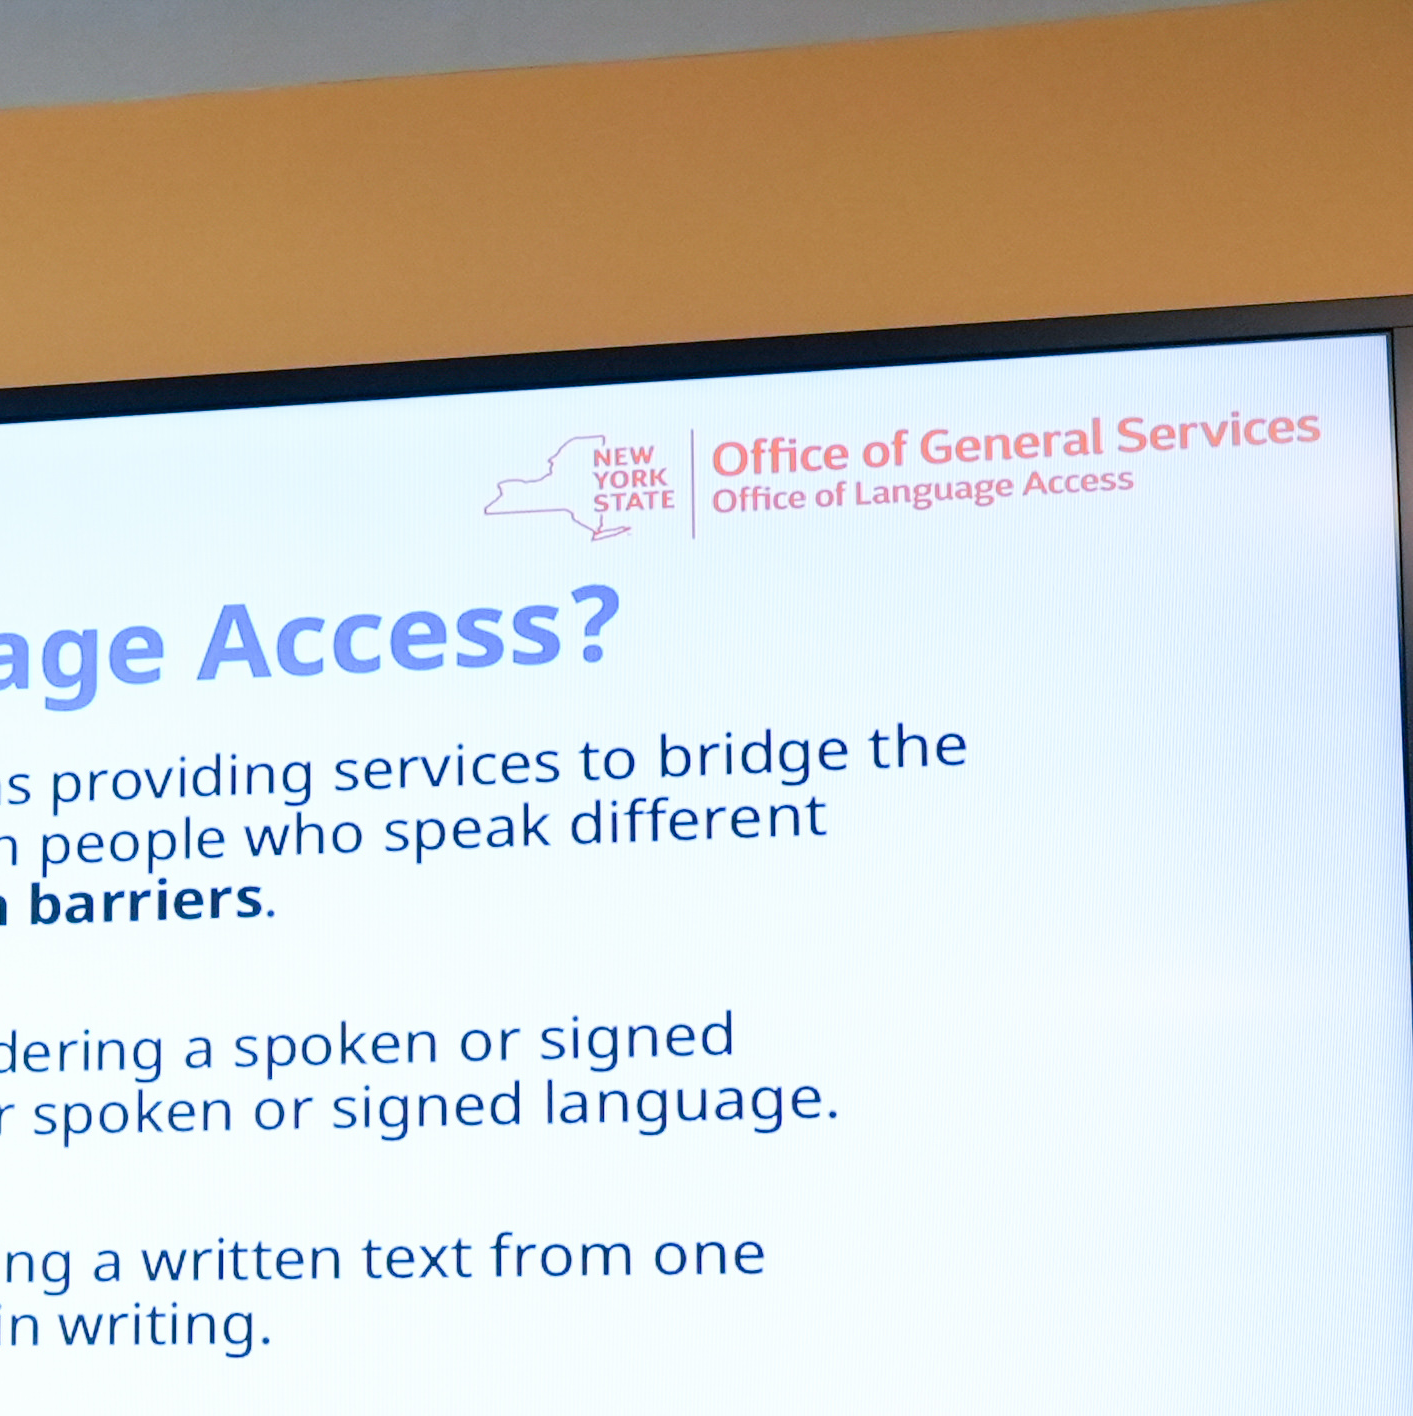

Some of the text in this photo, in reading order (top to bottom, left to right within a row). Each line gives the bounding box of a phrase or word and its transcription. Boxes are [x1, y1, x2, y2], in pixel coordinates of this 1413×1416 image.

[593, 445, 655, 468] NEW
[712, 410, 1321, 476] Office of General Services
[593, 468, 668, 490] YORK
[593, 490, 676, 512] STATE
[712, 468, 1135, 514] Office of Language Access
[197, 584, 620, 680] Access?
[49, 752, 312, 815] providing
[334, 742, 560, 792] services
[580, 740, 635, 781] to
[661, 728, 849, 786] bridge
[869, 723, 967, 769] the
[41, 818, 225, 877] people
[245, 811, 363, 858] who
[385, 802, 551, 864] speak
[571, 795, 827, 846] different
[30, 876, 275, 923] barriers.
[185, 1036, 213, 1069] a
[234, 1020, 437, 1080] spoken
[460, 1026, 521, 1062] or
[540, 1009, 733, 1072] signed
[34, 1088, 231, 1148] spoken
[254, 1094, 313, 1132] or
[333, 1080, 521, 1142] signed
[546, 1080, 838, 1135] language.
[93, 1248, 121, 1284] a
[143, 1237, 341, 1282] written
[362, 1238, 473, 1279] text
[490, 1232, 631, 1278] from
[654, 1240, 765, 1276] one
[59, 1302, 271, 1358] writing.
